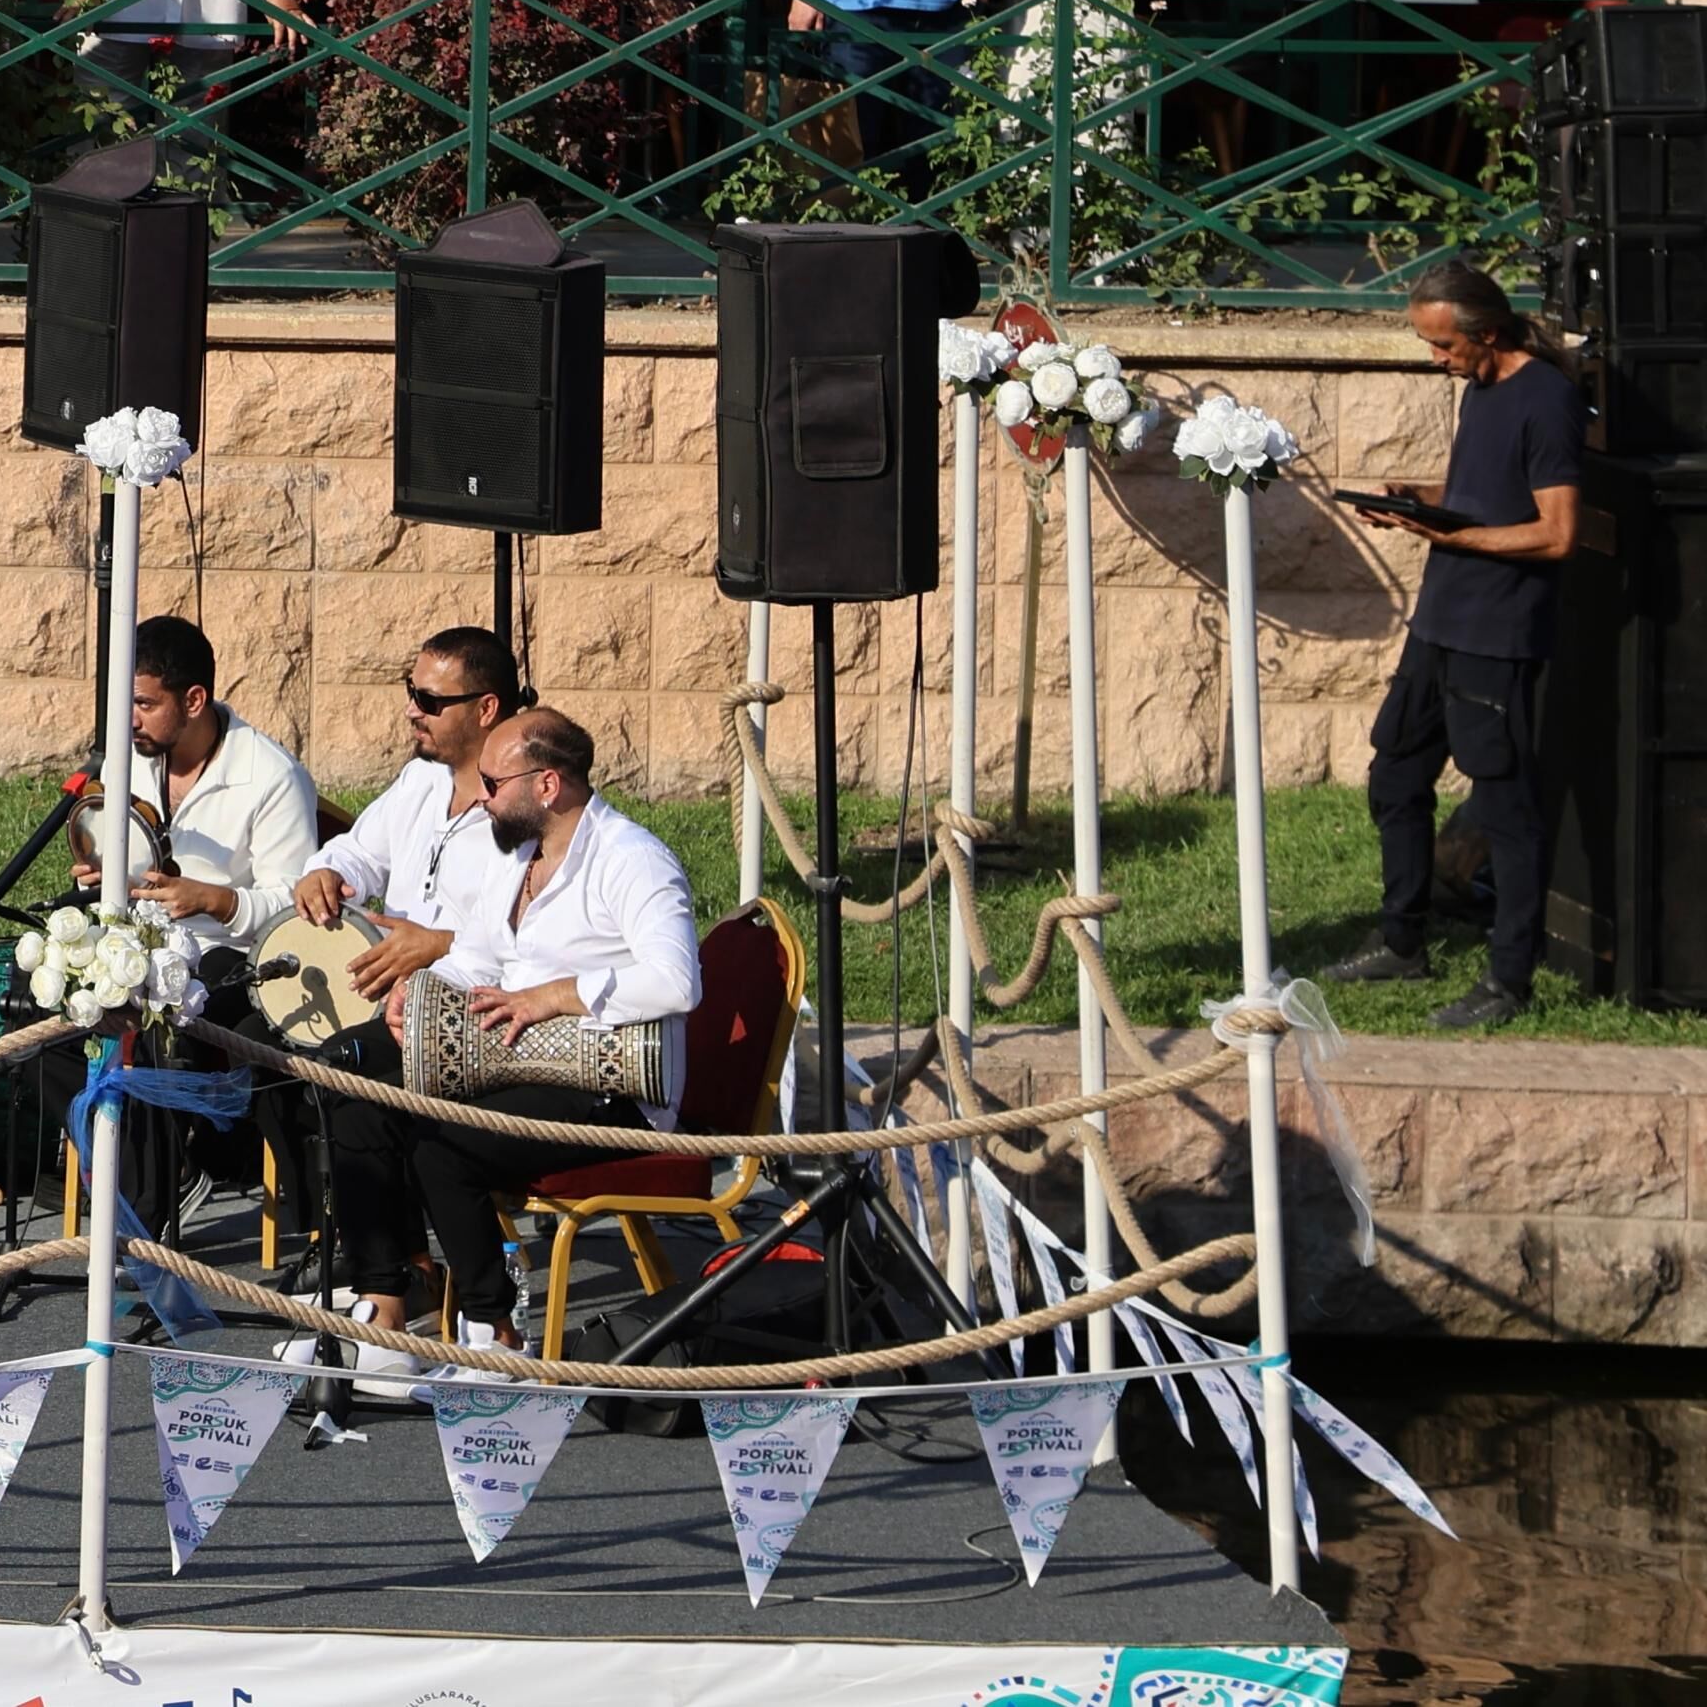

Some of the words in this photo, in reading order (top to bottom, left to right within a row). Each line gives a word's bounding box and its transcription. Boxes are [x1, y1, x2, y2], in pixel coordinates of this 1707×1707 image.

[179, 1410, 248, 1432] PORSUK
[1006, 1428, 1076, 1439] PORSUK
[463, 1436, 533, 1451] PORSUK
[738, 1448, 809, 1460] PORSUK
